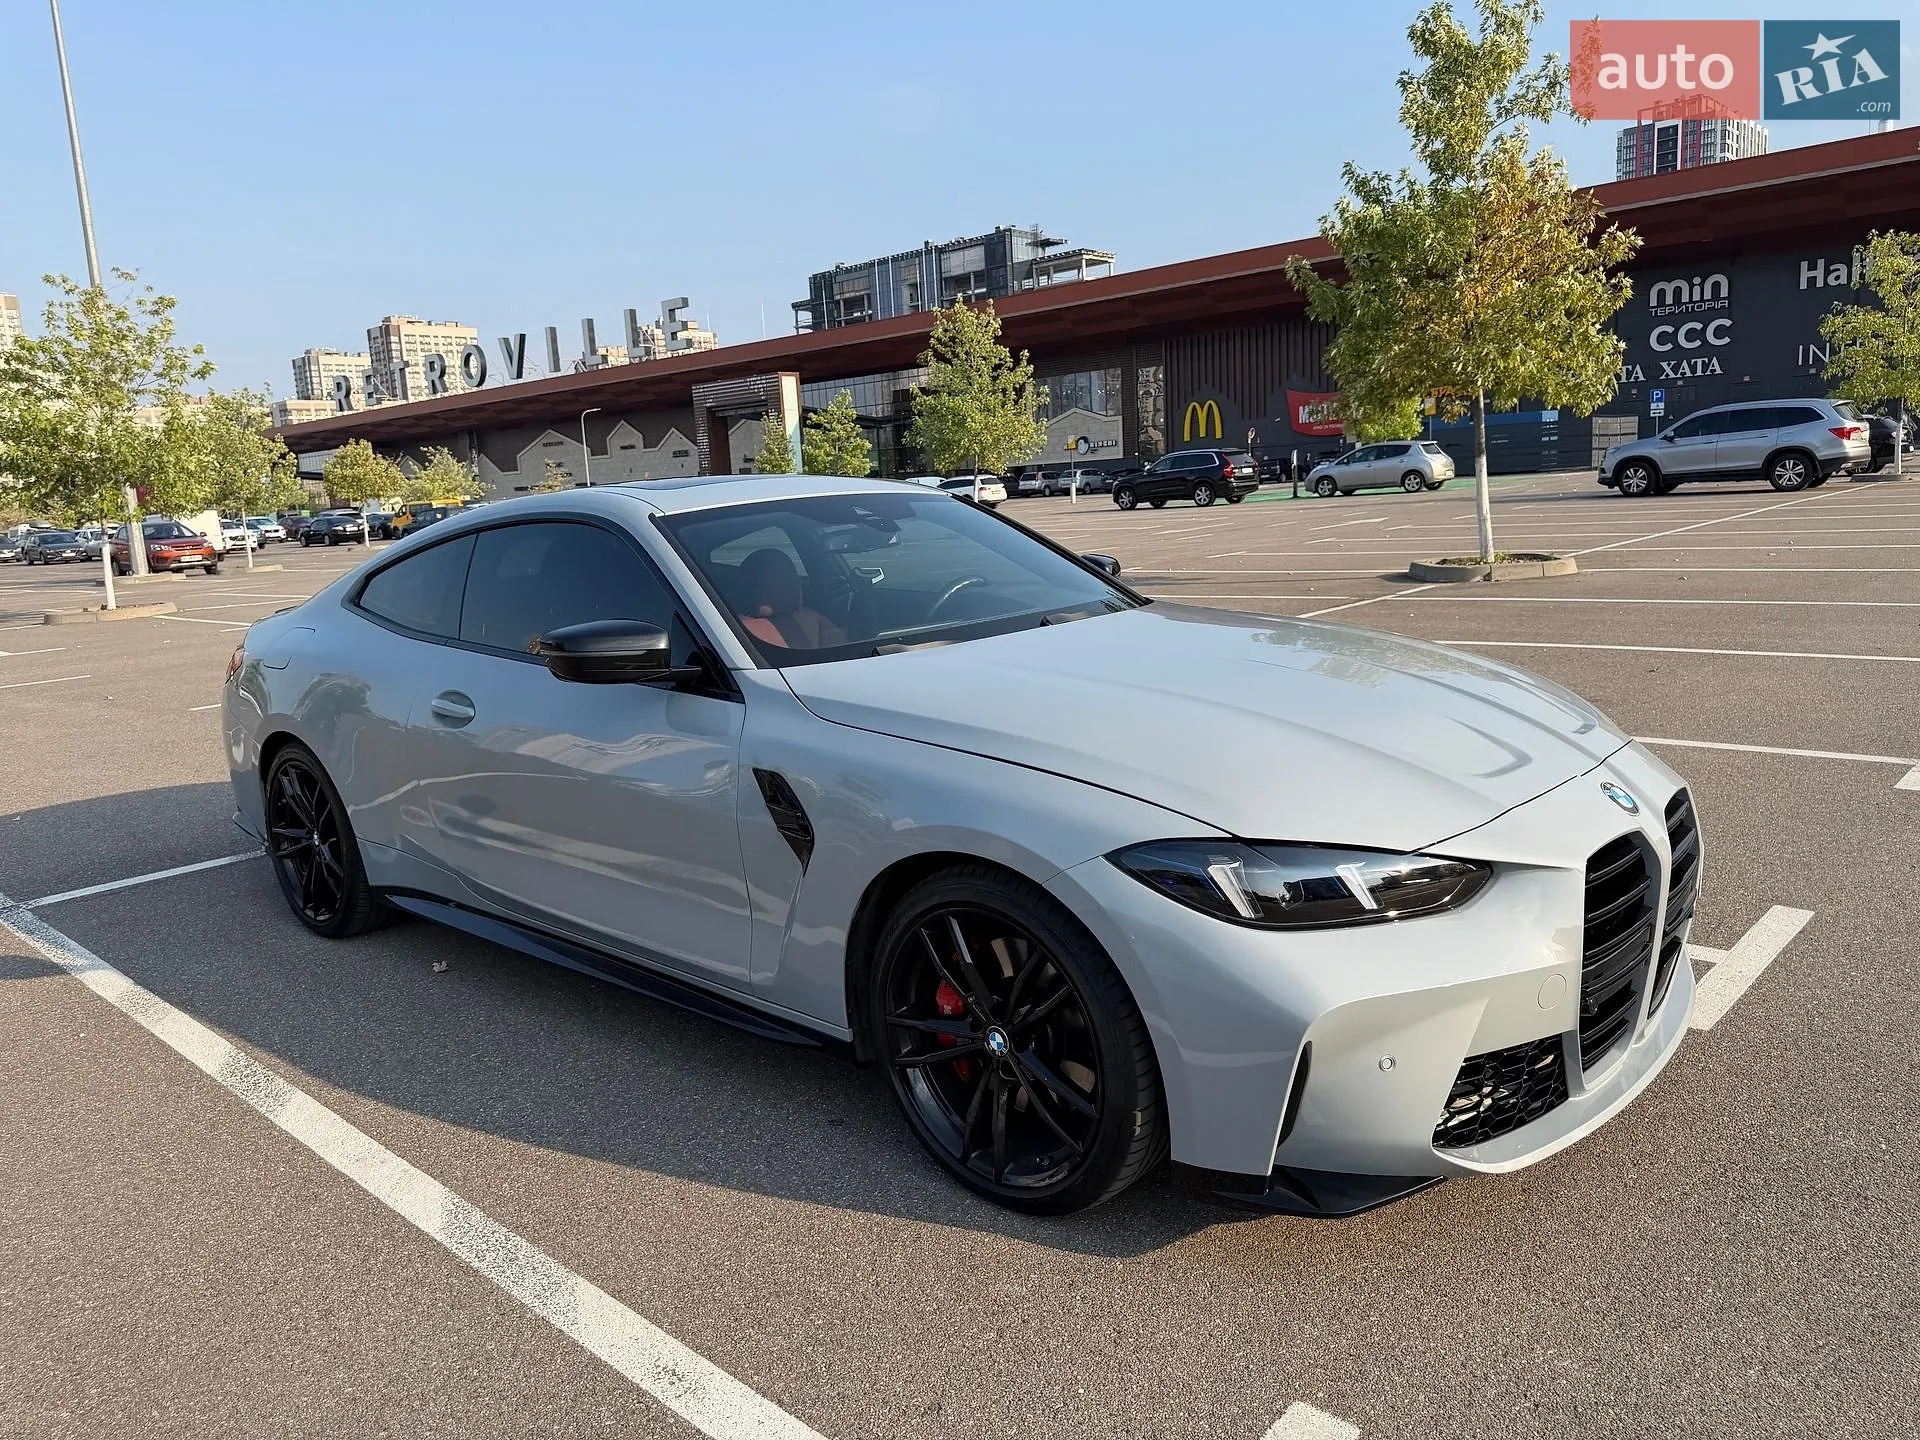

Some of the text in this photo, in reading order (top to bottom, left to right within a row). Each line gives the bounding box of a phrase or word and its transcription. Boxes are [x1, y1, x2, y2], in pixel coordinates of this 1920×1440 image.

[1649, 299, 1728, 317] ТЕРИТОРІЯ
[335, 296, 693, 412] RETROVILLE
[1659, 356, 1724, 380] ХАТА
